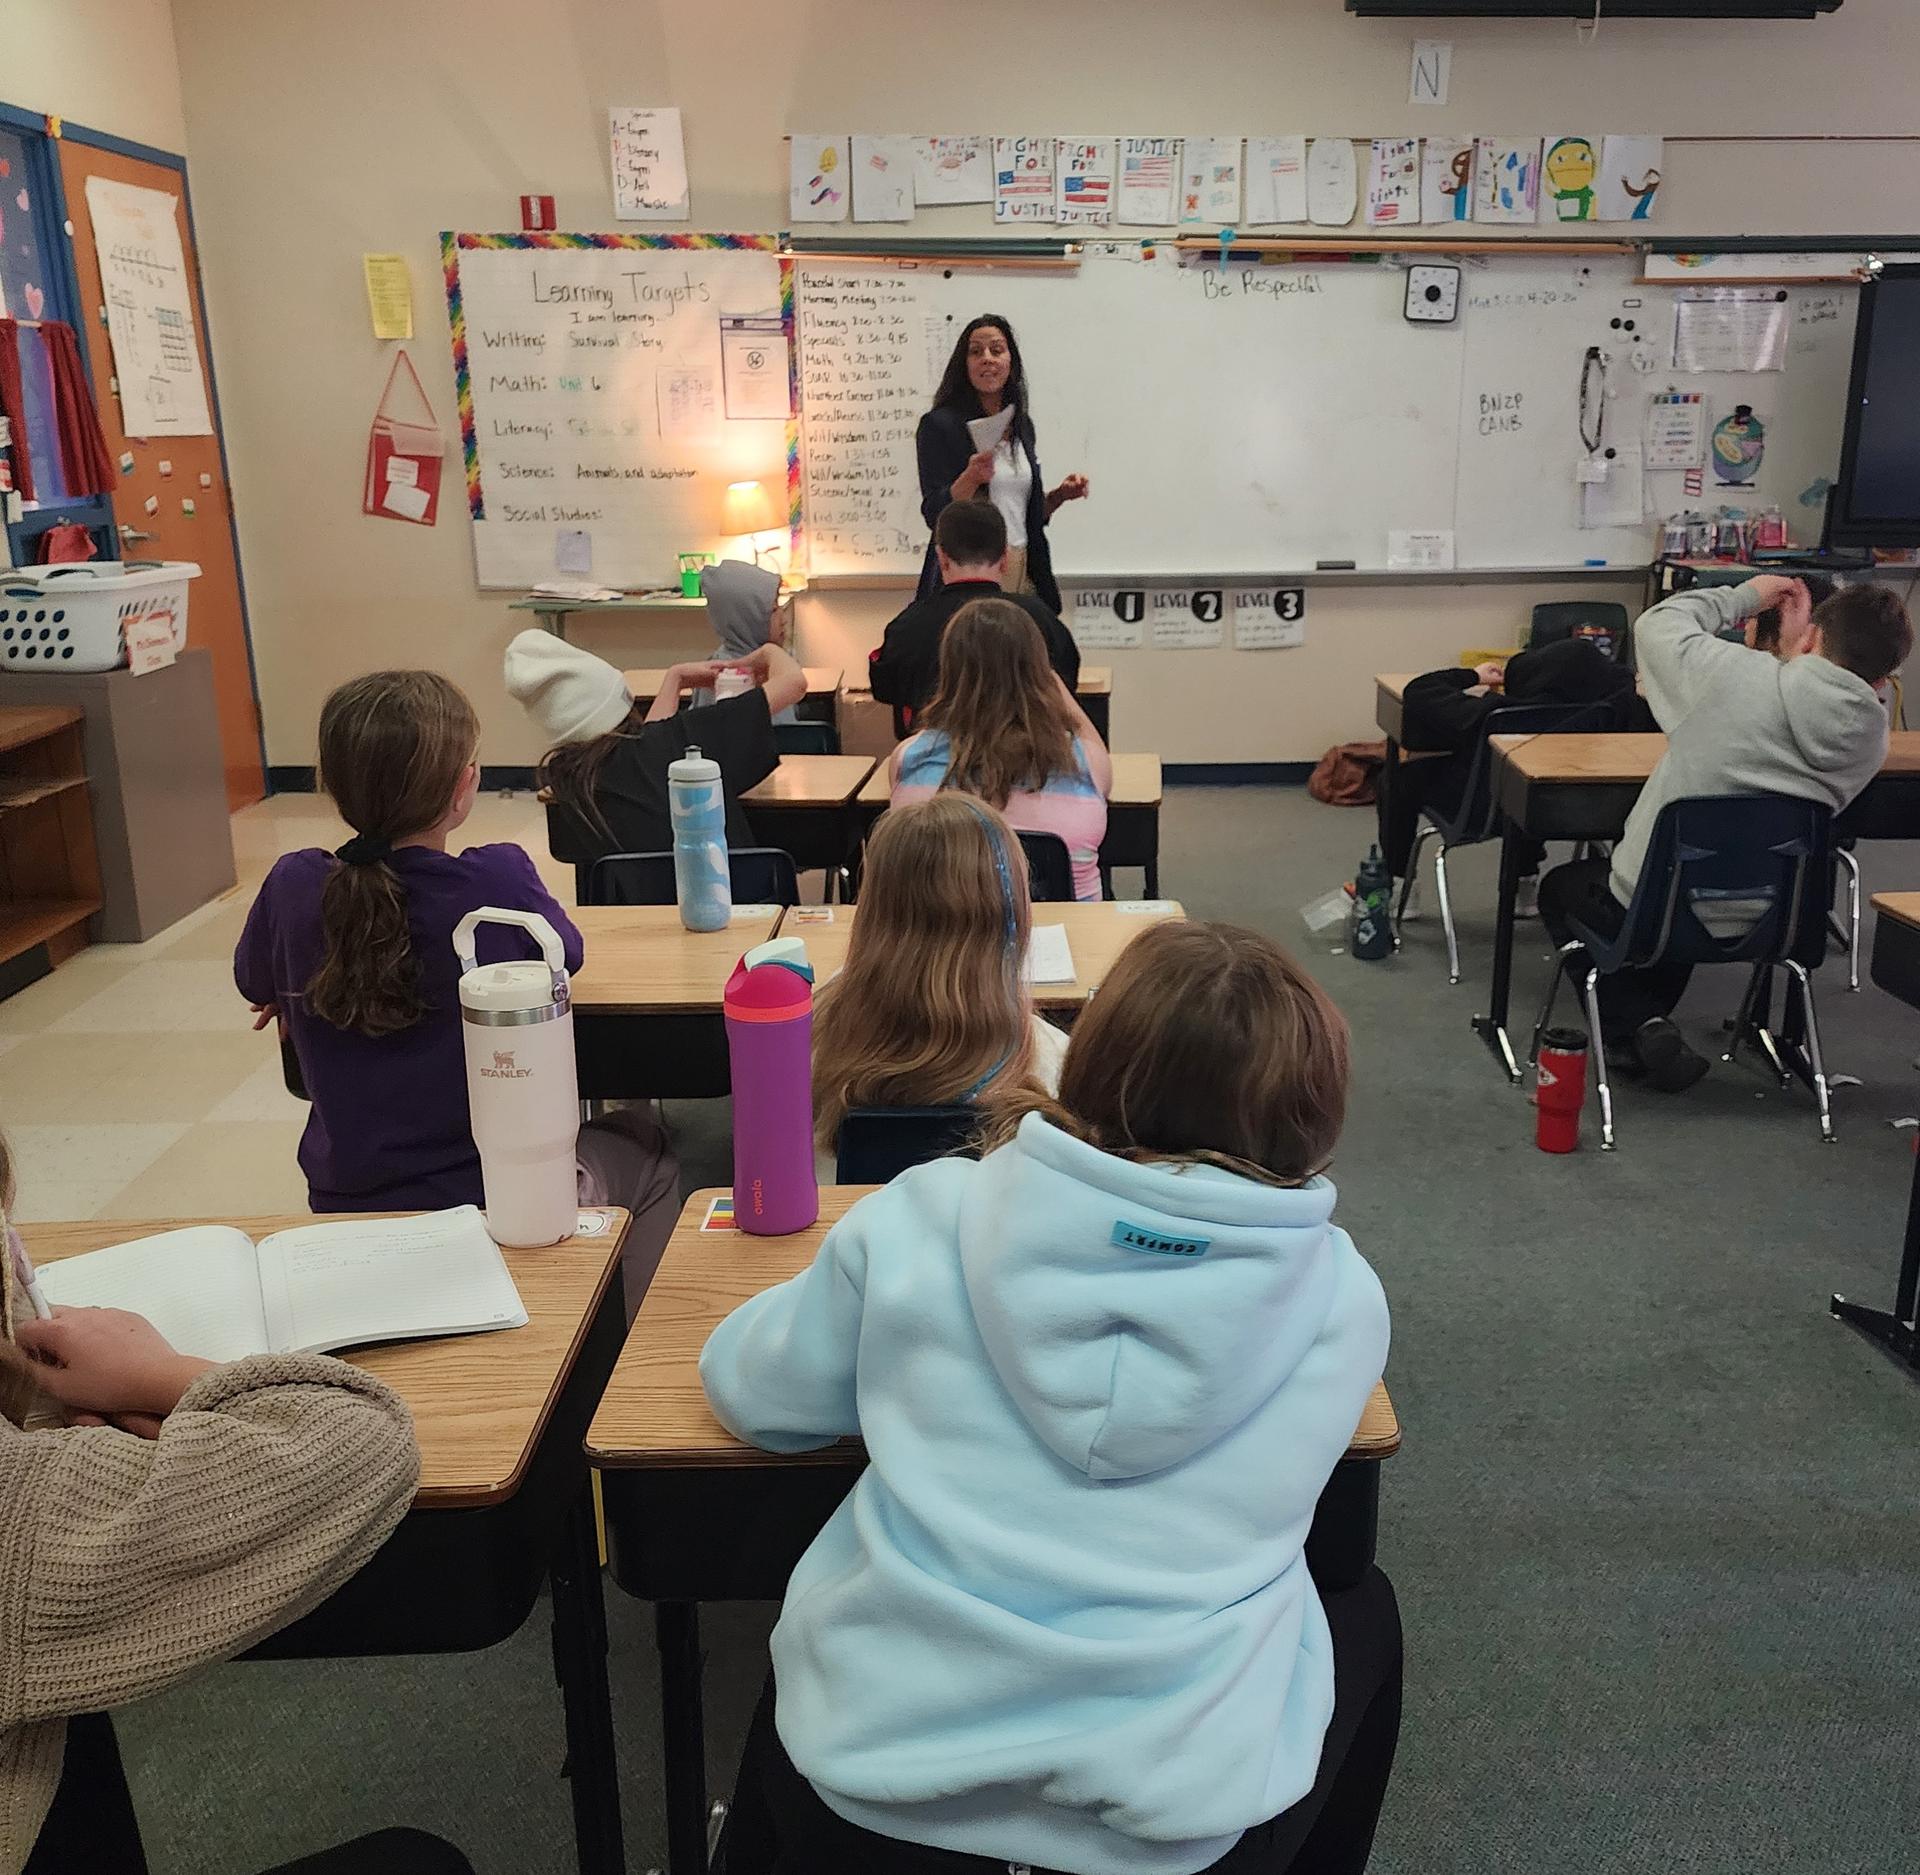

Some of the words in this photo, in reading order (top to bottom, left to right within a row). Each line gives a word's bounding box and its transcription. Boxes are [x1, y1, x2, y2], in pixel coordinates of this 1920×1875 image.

[1414, 52, 1440, 98] N
[533, 271, 613, 308] Learning
[621, 271, 710, 315] Targets
[1202, 269, 1232, 300] Be
[571, 311, 581, 324] I
[483, 331, 547, 354] Writing:
[490, 376, 547, 392] Math:
[493, 418, 553, 440] Literacy:
[500, 462, 554, 479] Science:
[503, 504, 547, 521] Social
[552, 504, 603, 521] Studies:
[1076, 593, 1111, 608] LEVEL
[1125, 594, 1136, 621] 1
[1154, 593, 1189, 608] LEVEL
[1200, 593, 1218, 620] 2
[1235, 593, 1270, 608] LEVEL
[1282, 592, 1299, 618] 3
[480, 1067, 533, 1079] STANLEY
[752, 1179, 764, 1216] owala
[1123, 1231, 1197, 1253] COMFRT
